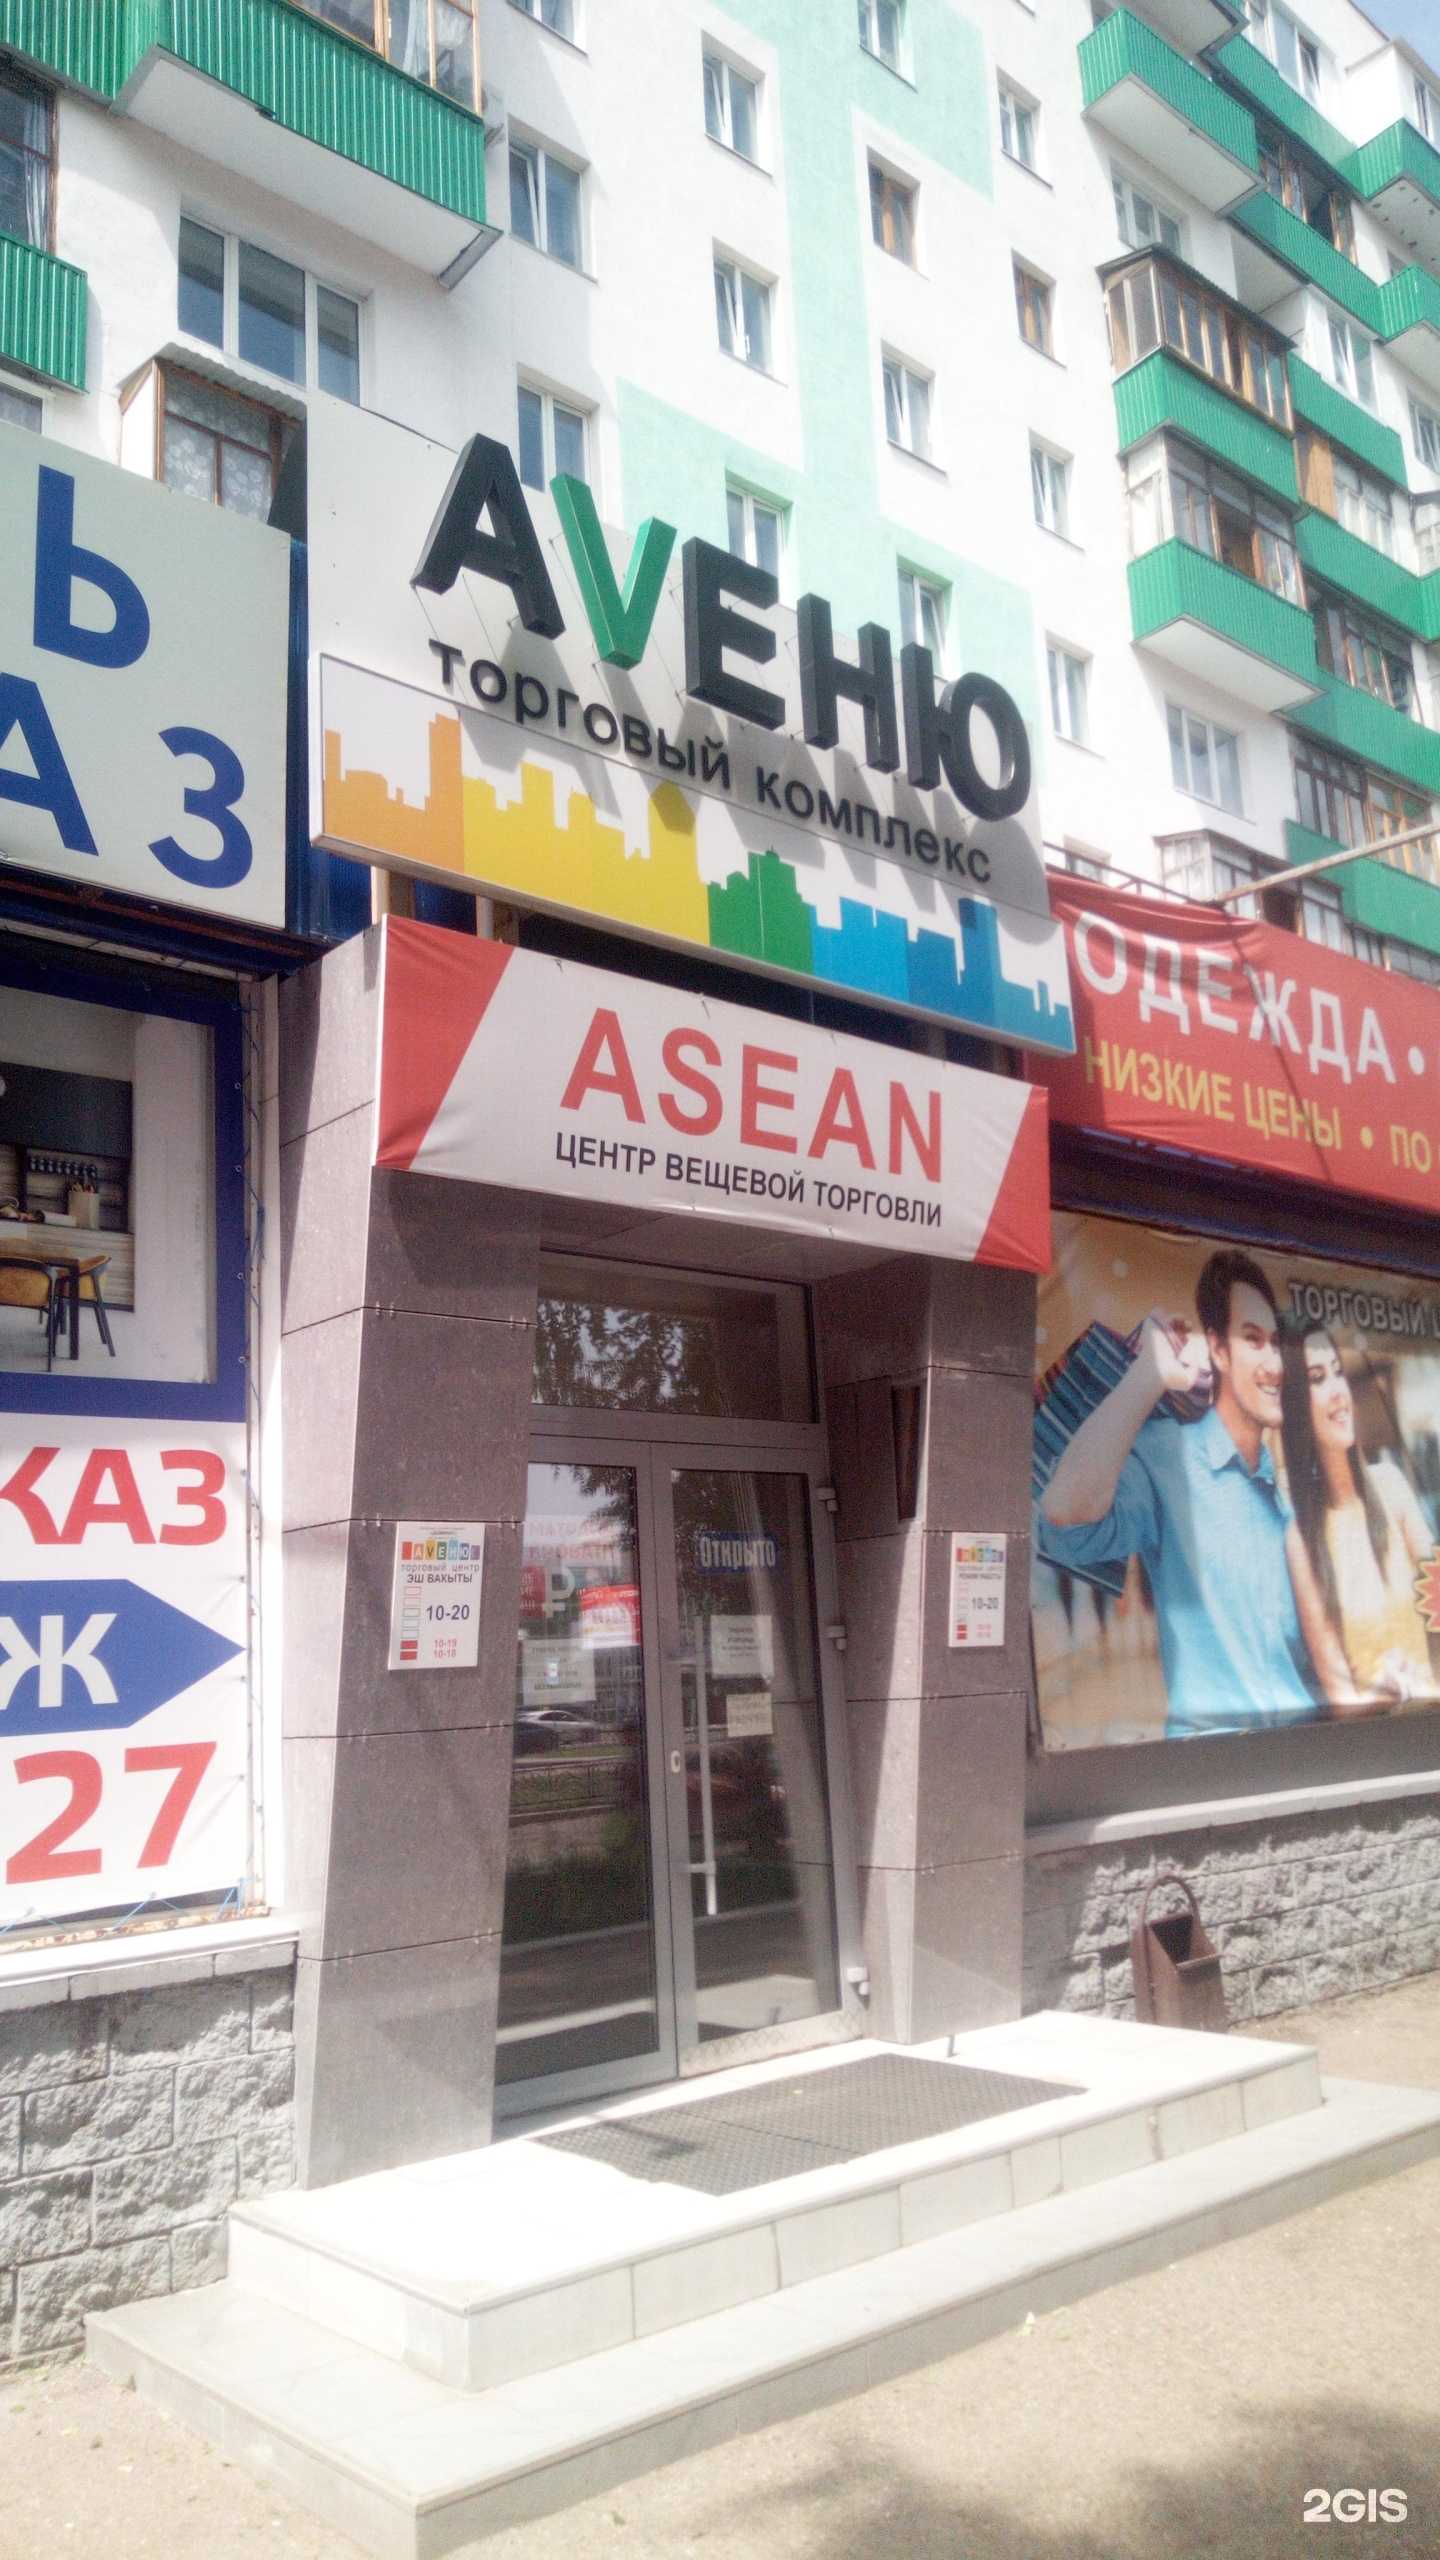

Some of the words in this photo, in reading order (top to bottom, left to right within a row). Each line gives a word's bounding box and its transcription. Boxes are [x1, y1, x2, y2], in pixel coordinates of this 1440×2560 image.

[429, 639, 732, 789] торговый
[755, 765, 992, 885] комплекс
[1073, 911, 1397, 1084] ОДЕЖДА
[559, 1006, 942, 1183] ASEAN
[1084, 1036, 1235, 1122] НИЗКИЕ
[1243, 1082, 1342, 1151] ЦЕНЫ
[1390, 1125, 1432, 1174] ПО
[556, 1132, 656, 1177] ЦЕНТР
[665, 1153, 804, 1202] ВЕЩЕВОЙ
[813, 1181, 942, 1228] ТОРГОВЛИ
[1288, 1280, 1426, 1336] ТОРГОВЫЙ
[426, 1604, 470, 1621] 10-20
[6, 1741, 218, 1885] 27
